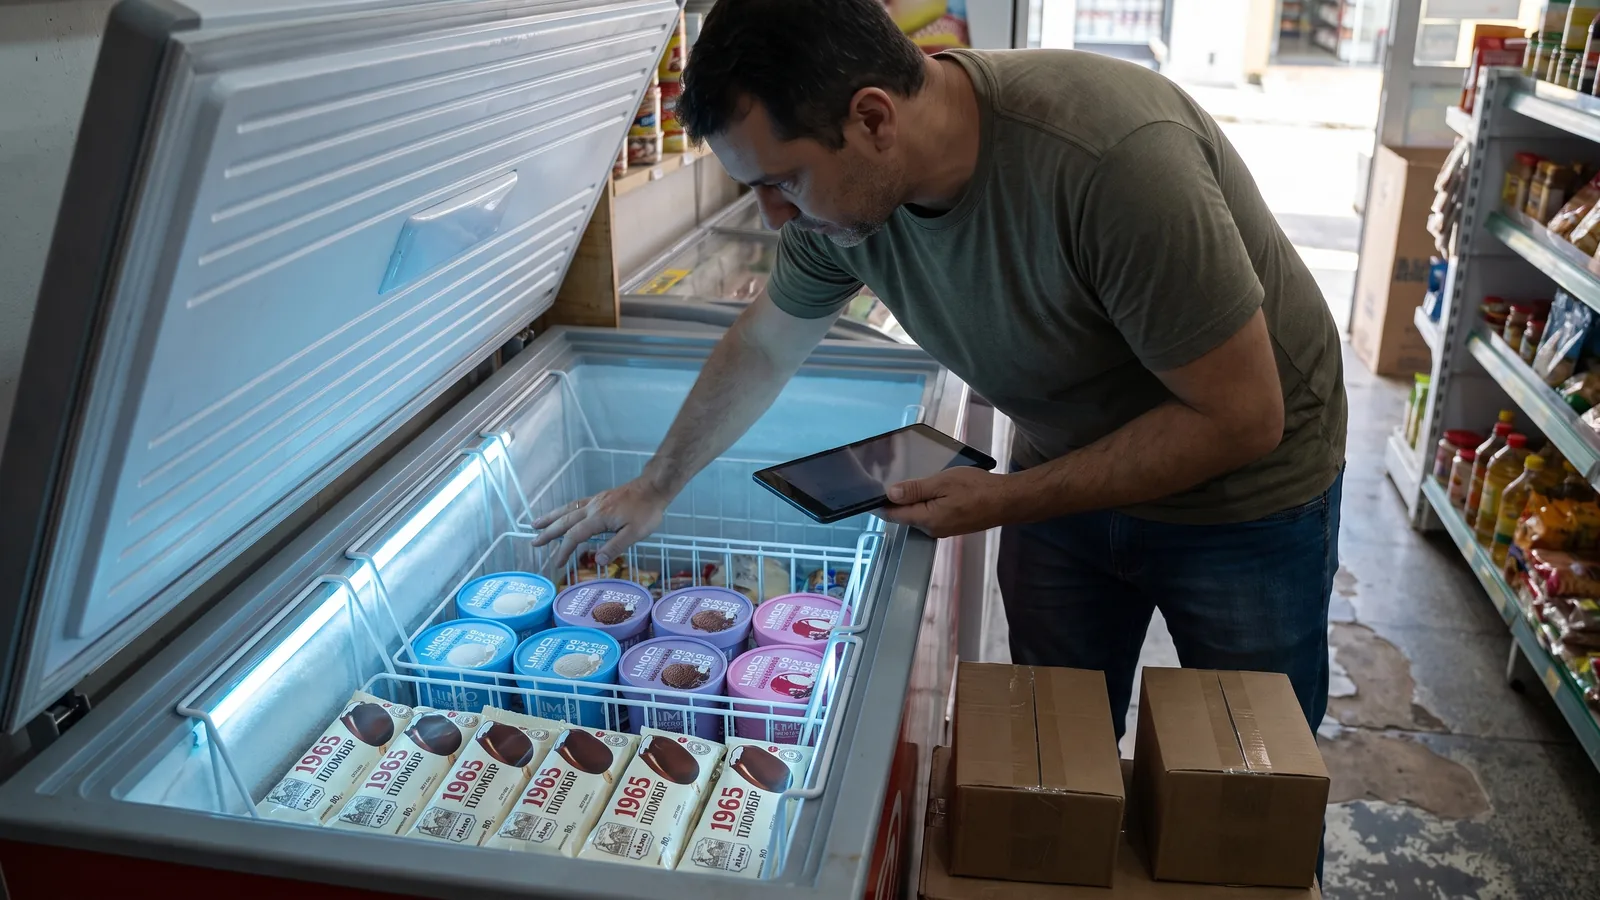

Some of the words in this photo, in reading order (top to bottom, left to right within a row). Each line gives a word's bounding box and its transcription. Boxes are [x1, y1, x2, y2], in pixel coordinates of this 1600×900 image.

[295, 736, 341, 775] 1965
[316, 739, 356, 783] ПЛОМБІР
[365, 750, 408, 791] 1965
[386, 752, 424, 797] ПЛОМБІР
[442, 760, 484, 803] 1965
[464, 763, 500, 809] ПЛОМБІР
[522, 767, 562, 808] 1965
[546, 771, 579, 815] ПЛОМБІР
[614, 776, 651, 819] 1965
[640, 781, 668, 826] ПЛОМБІР
[710, 787, 744, 833] 1965
[737, 790, 762, 839] ПЛОМБІР
